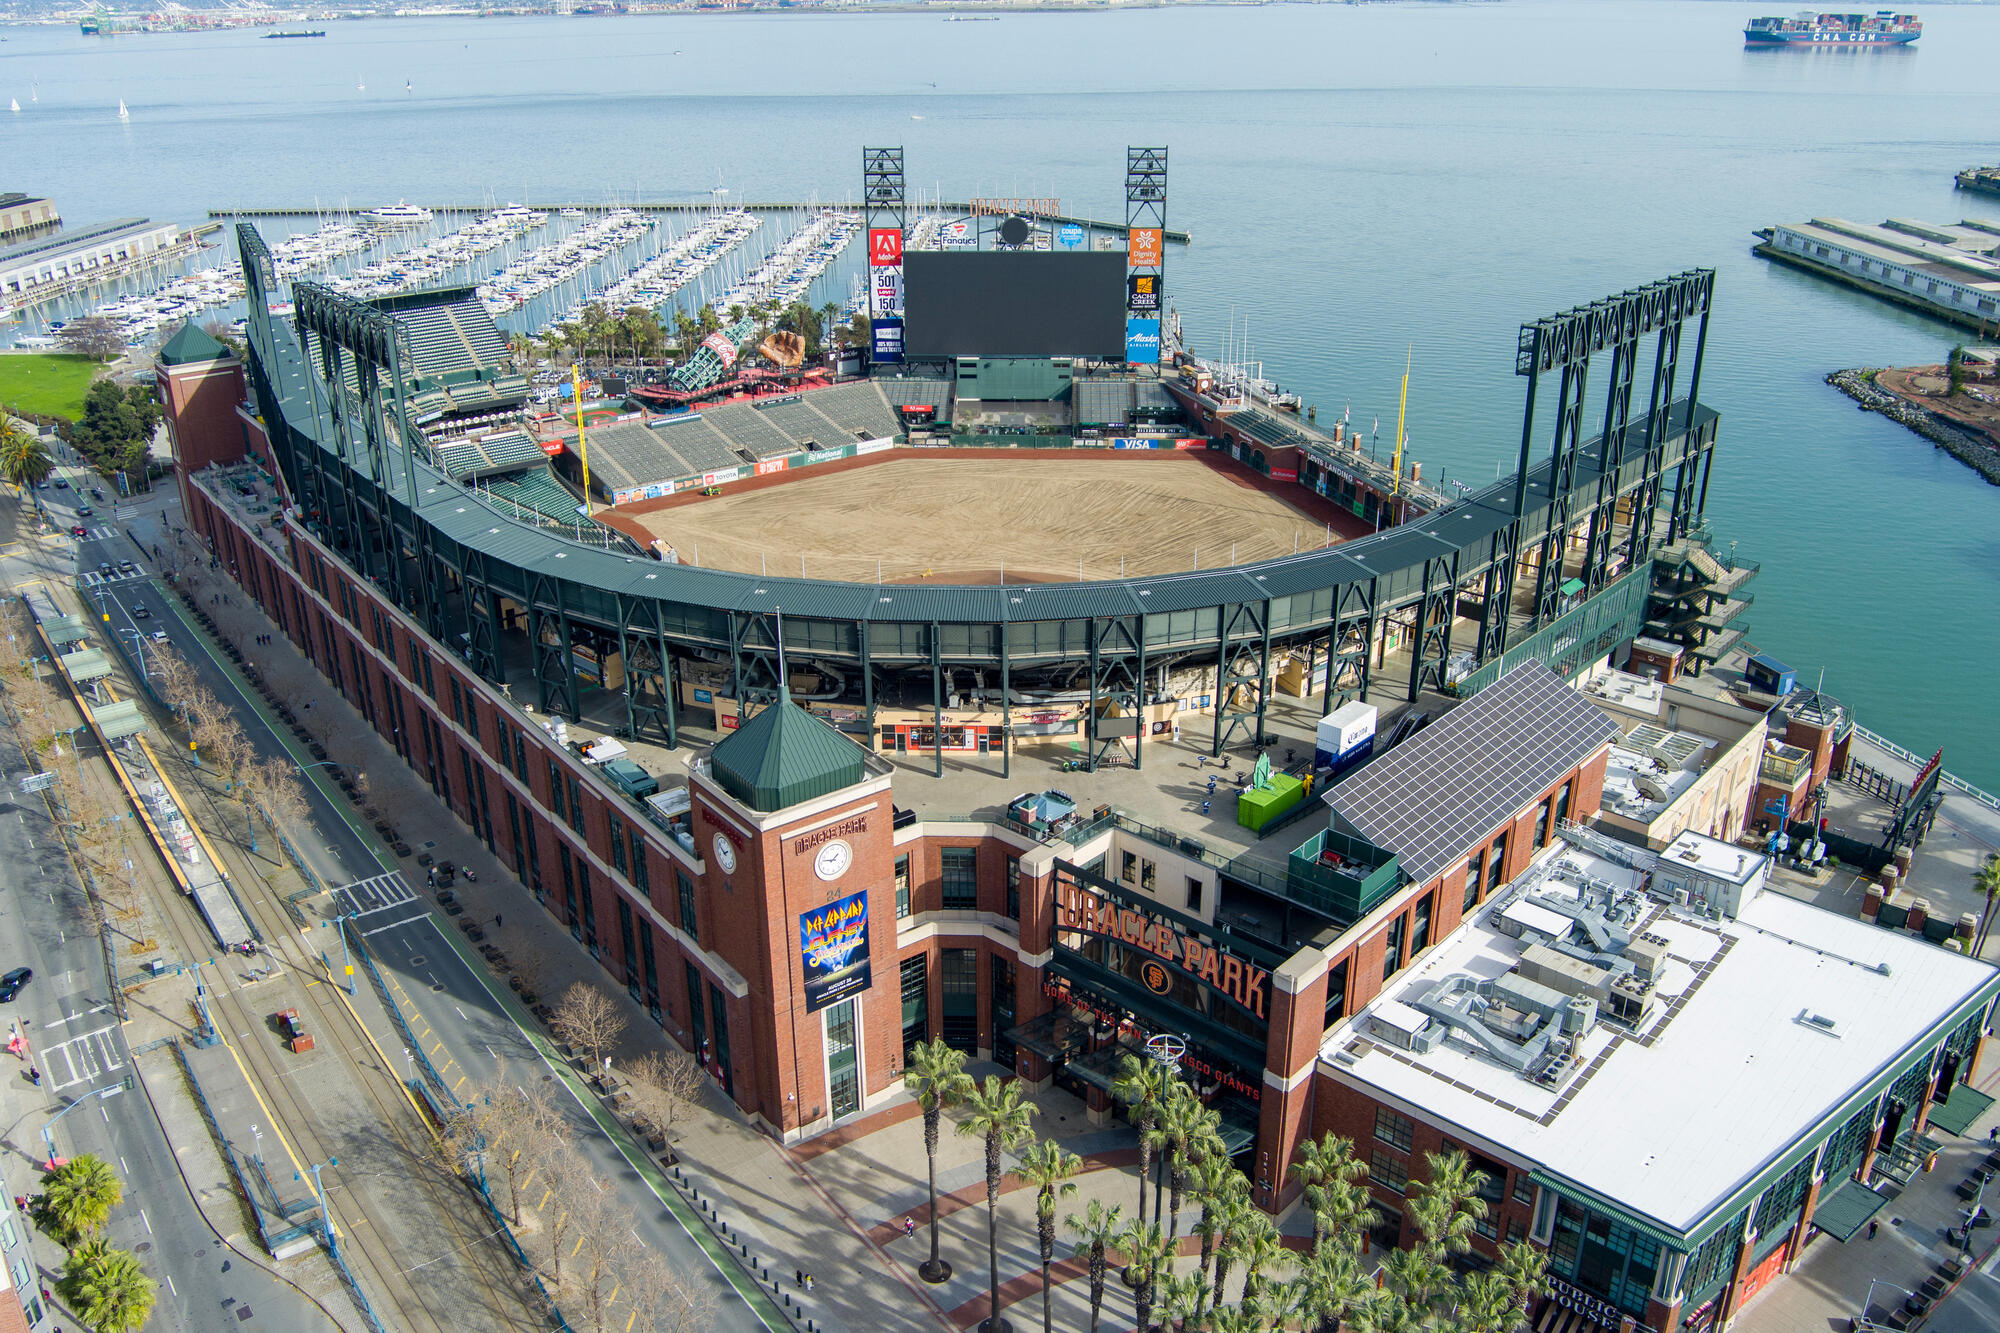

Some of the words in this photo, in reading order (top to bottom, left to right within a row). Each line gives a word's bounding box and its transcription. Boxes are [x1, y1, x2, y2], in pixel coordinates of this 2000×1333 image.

[970, 198, 1021, 217] ORACLE
[1025, 198, 1060, 217] PARK
[942, 236, 976, 245] Fanatics
[878, 275, 895, 288] 501
[879, 298, 895, 310] 150
[1128, 333, 1158, 343] Alaska
[1122, 440, 1149, 449] VISA
[816, 448, 842, 460] National
[715, 472, 737, 481] TOYOTA
[1324, 461, 1353, 482] LANDING
[795, 828, 837, 857] ORACLE
[838, 817, 868, 836] PARK
[827, 887, 842, 902] 24
[806, 914, 823, 938] DEF
[823, 898, 864, 929] LEPPARD
[1063, 882, 1174, 961] ORACLE
[1182, 936, 1267, 1020] PARK
[1043, 983, 1073, 1006] HOME
[1077, 1000, 1090, 1013] OF
[1094, 1009, 1116, 1027] THE
[1120, 1023, 1142, 1040] SAN
[1215, 1070, 1260, 1100] GIANTS
[1547, 1274, 1617, 1319] PUBLIC
[1544, 1289, 1614, 1331] HOUSE
